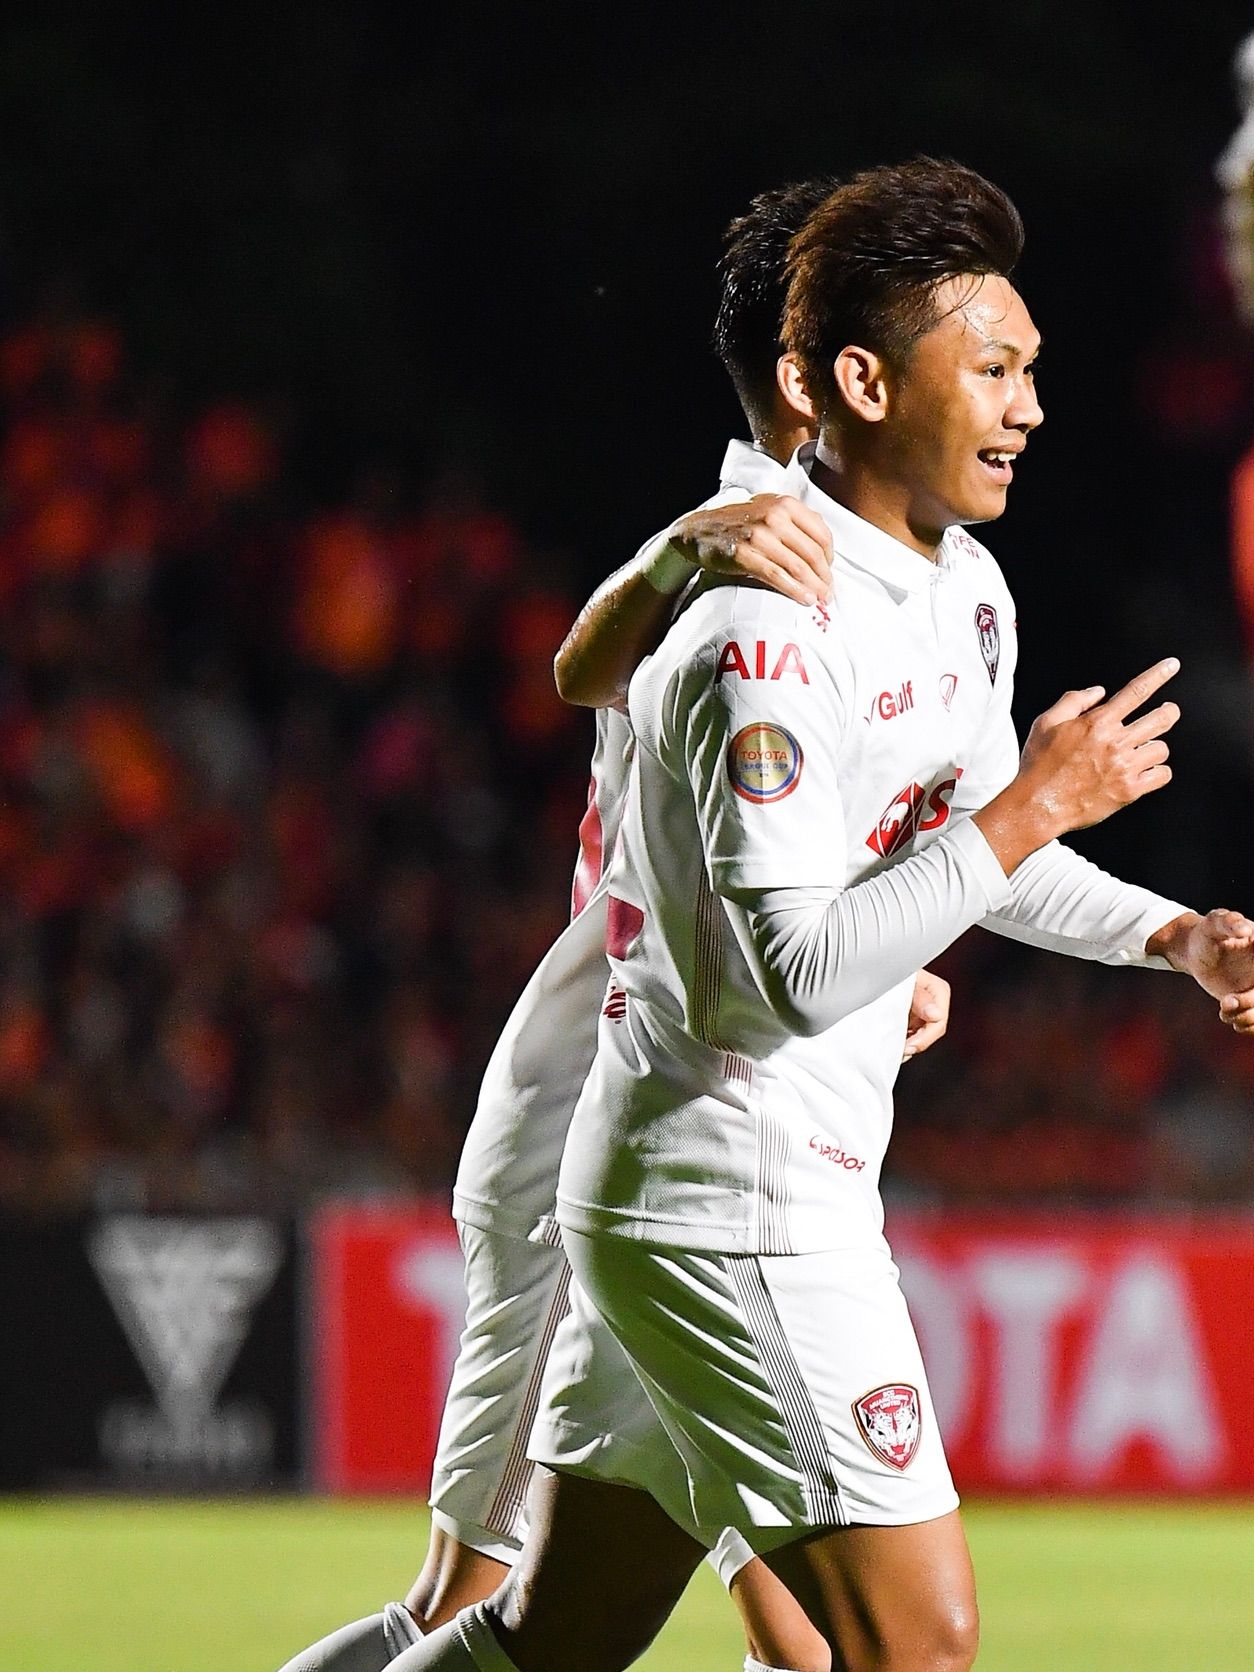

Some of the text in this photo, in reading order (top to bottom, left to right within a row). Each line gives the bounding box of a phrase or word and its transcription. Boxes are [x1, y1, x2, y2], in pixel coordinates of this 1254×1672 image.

[714, 641, 810, 685] AIA
[878, 680, 914, 720] Gulf
[741, 750, 788, 760] TOYOTA
